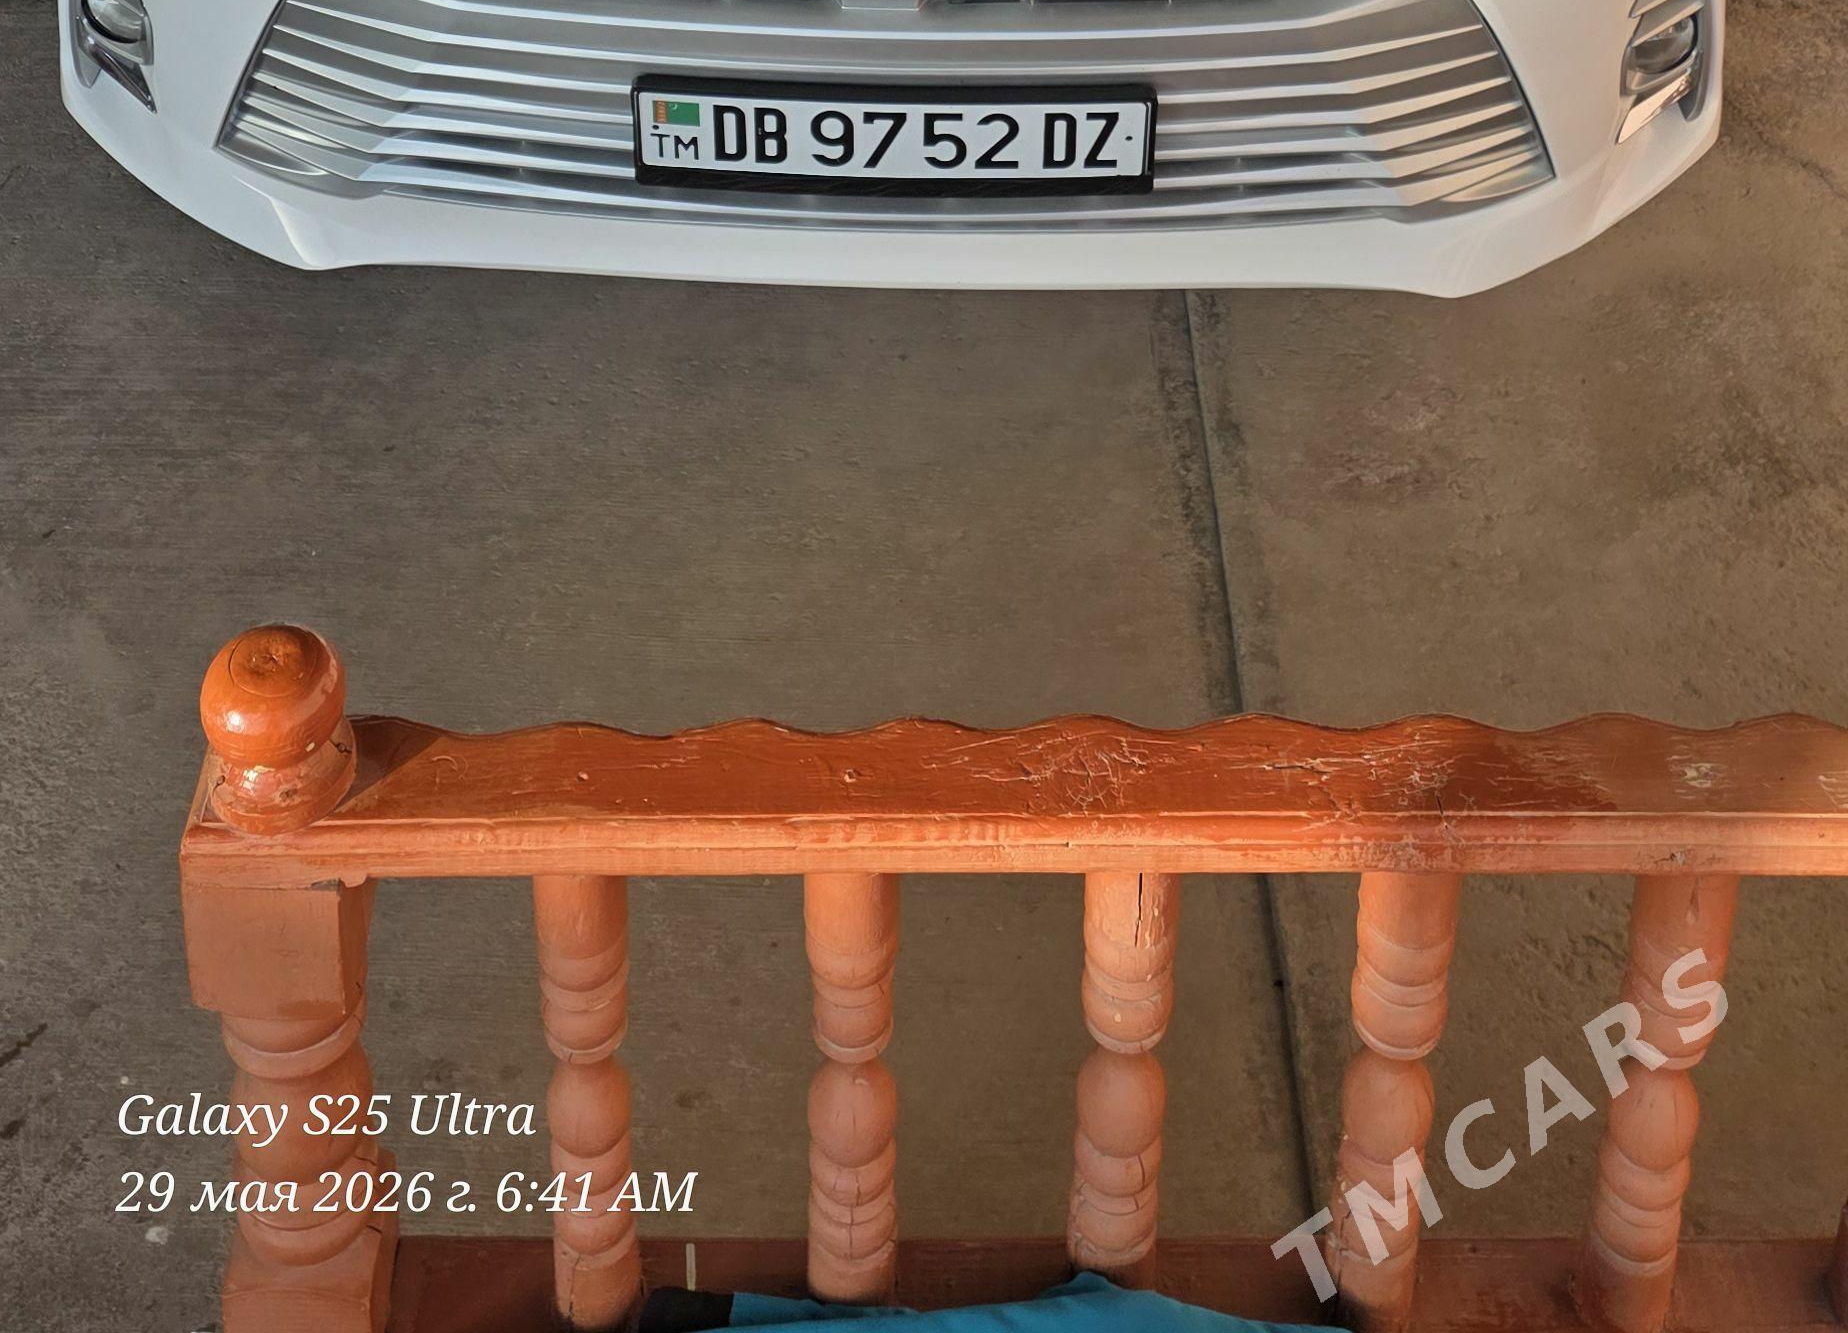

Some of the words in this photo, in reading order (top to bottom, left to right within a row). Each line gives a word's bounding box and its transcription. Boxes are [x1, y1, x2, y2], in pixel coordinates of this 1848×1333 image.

[650, 133, 700, 161] TM
[712, 104, 789, 165] DB
[1042, 111, 1121, 170] DZ
